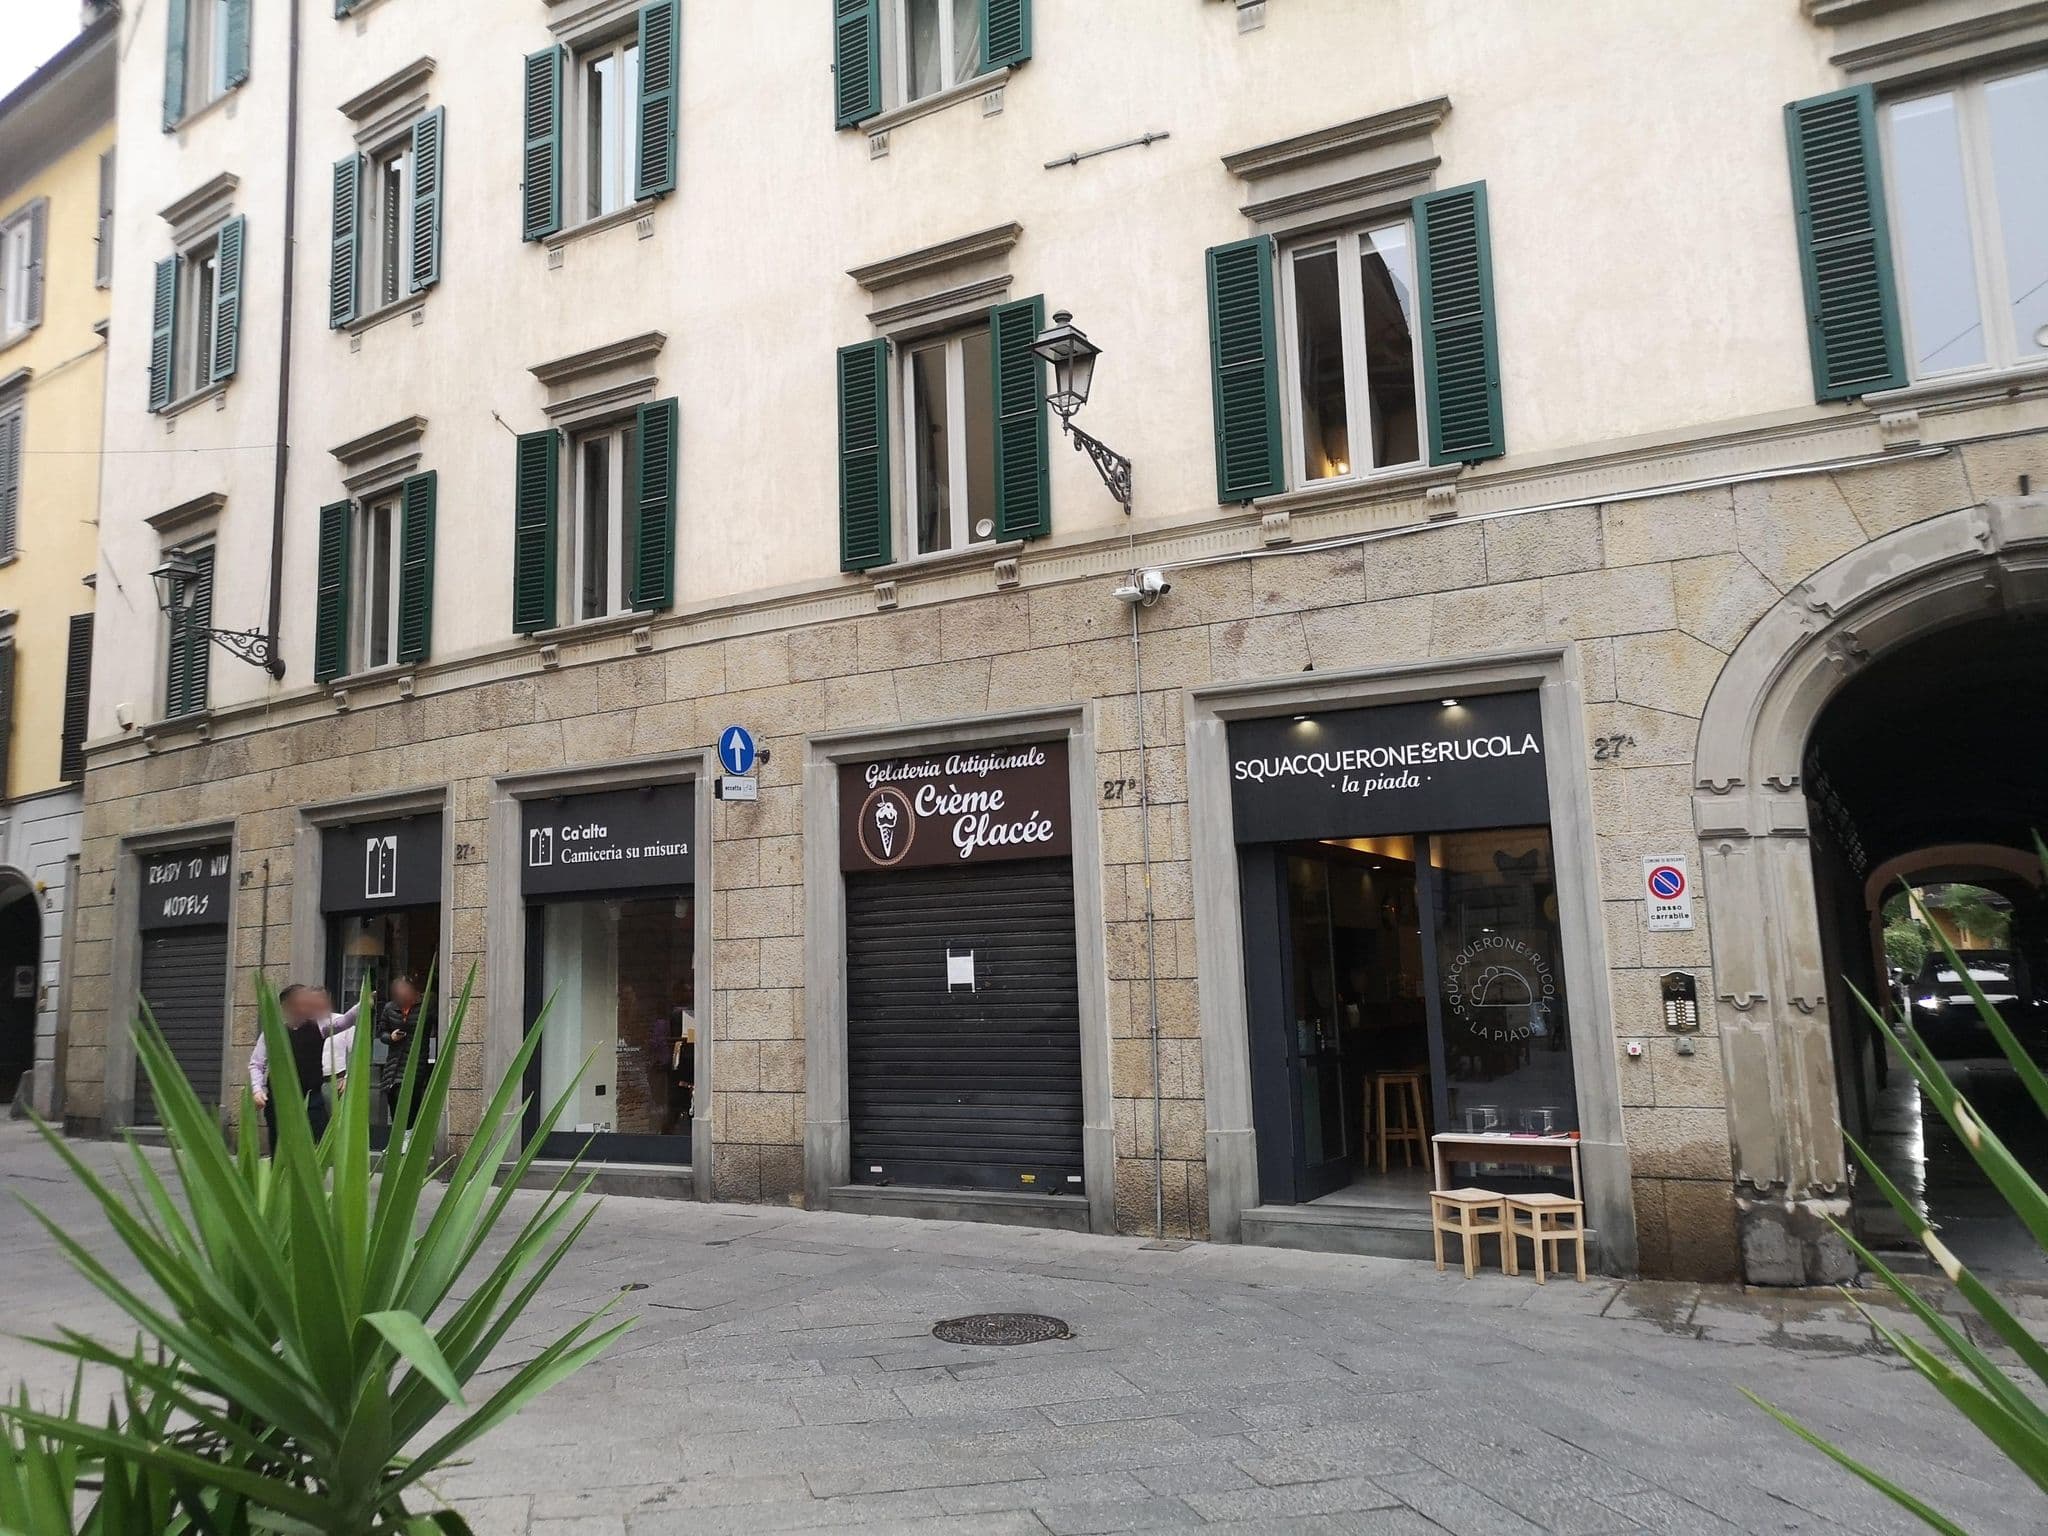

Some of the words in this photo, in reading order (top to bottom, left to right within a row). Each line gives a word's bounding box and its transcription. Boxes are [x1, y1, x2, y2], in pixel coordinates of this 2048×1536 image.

[865, 761, 942, 789] Gelateria
[945, 746, 1046, 778] Artigianale
[1234, 733, 1540, 783] SQUACQUERONE&RUCOLA
[1341, 776, 1360, 793] la
[1363, 771, 1420, 797] piada
[914, 784, 1005, 817] Crème
[953, 810, 1054, 859] Glacée
[561, 847, 623, 864] Camiceria
[626, 849, 640, 859] su
[643, 840, 688, 858] misura
[149, 861, 182, 884] READY
[188, 858, 203, 879] TO
[163, 895, 209, 917] MODELS
[1470, 1022, 1488, 1039] LA
[1494, 1020, 1537, 1042] PIADA
